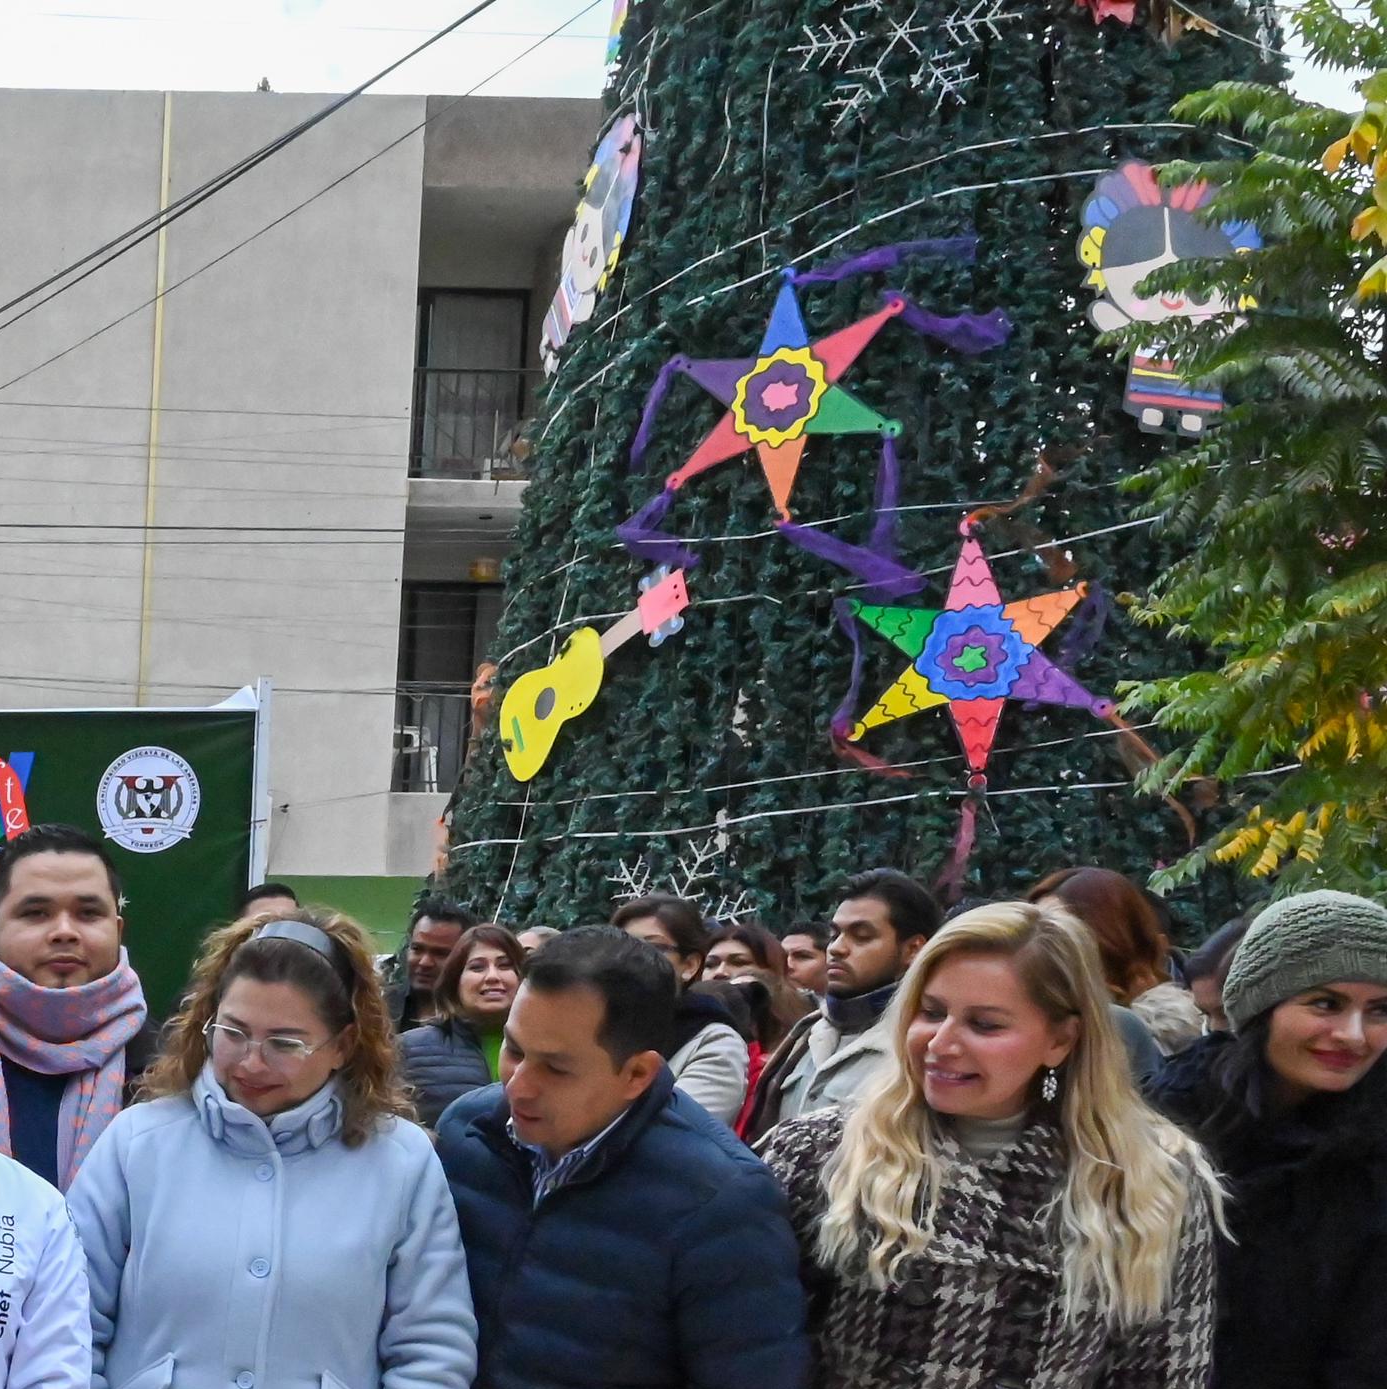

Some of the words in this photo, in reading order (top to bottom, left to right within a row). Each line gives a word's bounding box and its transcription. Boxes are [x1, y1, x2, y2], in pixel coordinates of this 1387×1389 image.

[127, 750, 158, 760] VIZCAYA
[160, 752, 170, 760] DE
[171, 757, 184, 768] LAS
